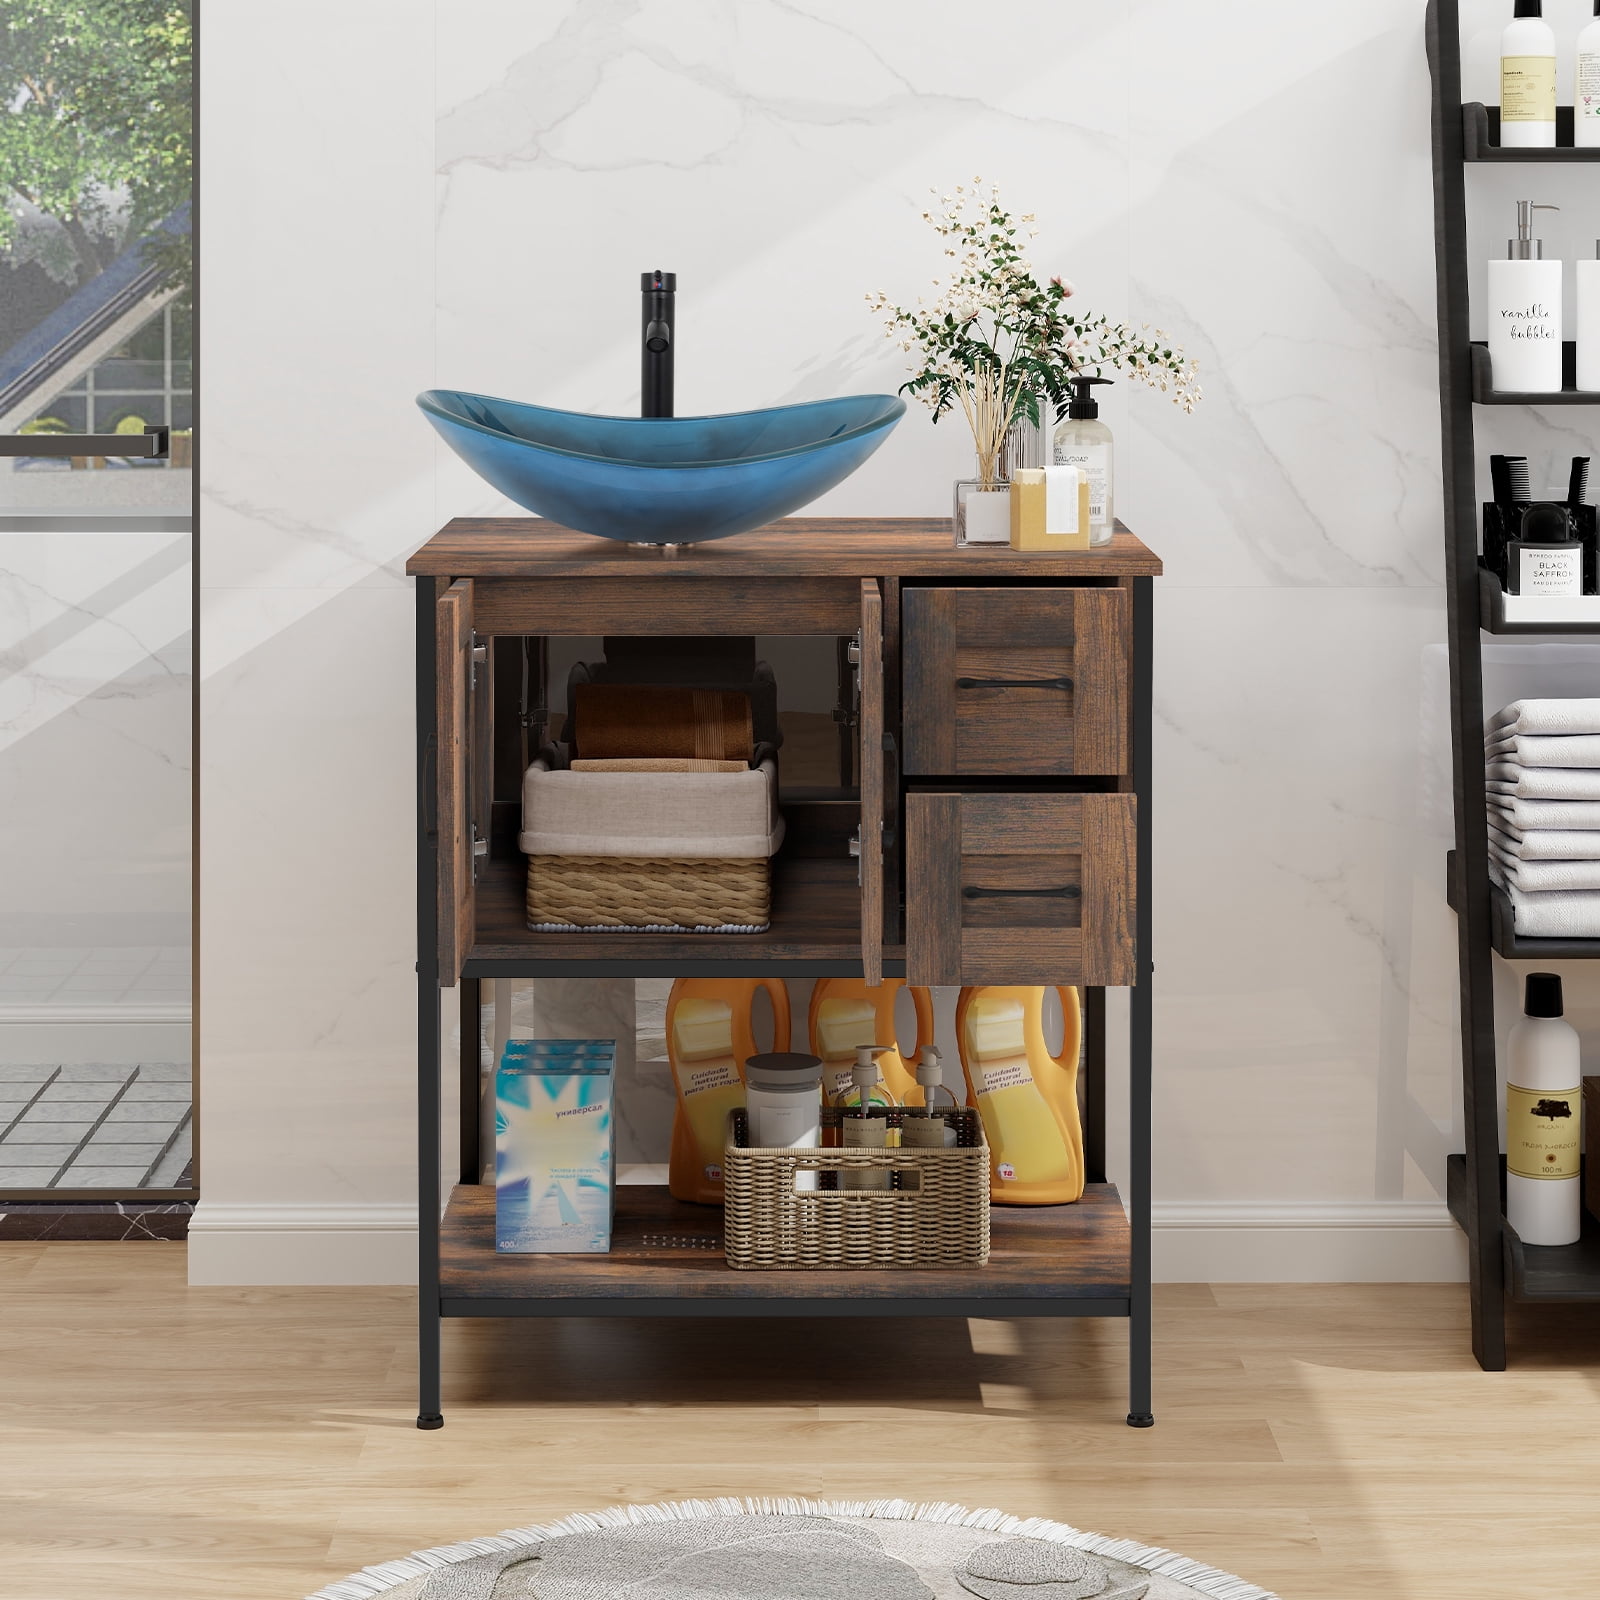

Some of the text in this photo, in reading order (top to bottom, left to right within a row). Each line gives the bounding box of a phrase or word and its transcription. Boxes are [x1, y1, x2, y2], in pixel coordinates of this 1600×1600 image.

[1501, 303, 1549, 319] vanilla
[1533, 570, 1573, 578] SAFFRON
[691, 1067, 728, 1081] Cuidado
[694, 1072, 729, 1087] natural
[984, 1066, 1021, 1080] Cuidado
[987, 1072, 1021, 1085] natural
[684, 1086, 705, 1097] para
[719, 1078, 741, 1086] ropa
[976, 1085, 997, 1096] para
[1012, 1077, 1033, 1085] ropa
[555, 1104, 603, 1119] универсал
